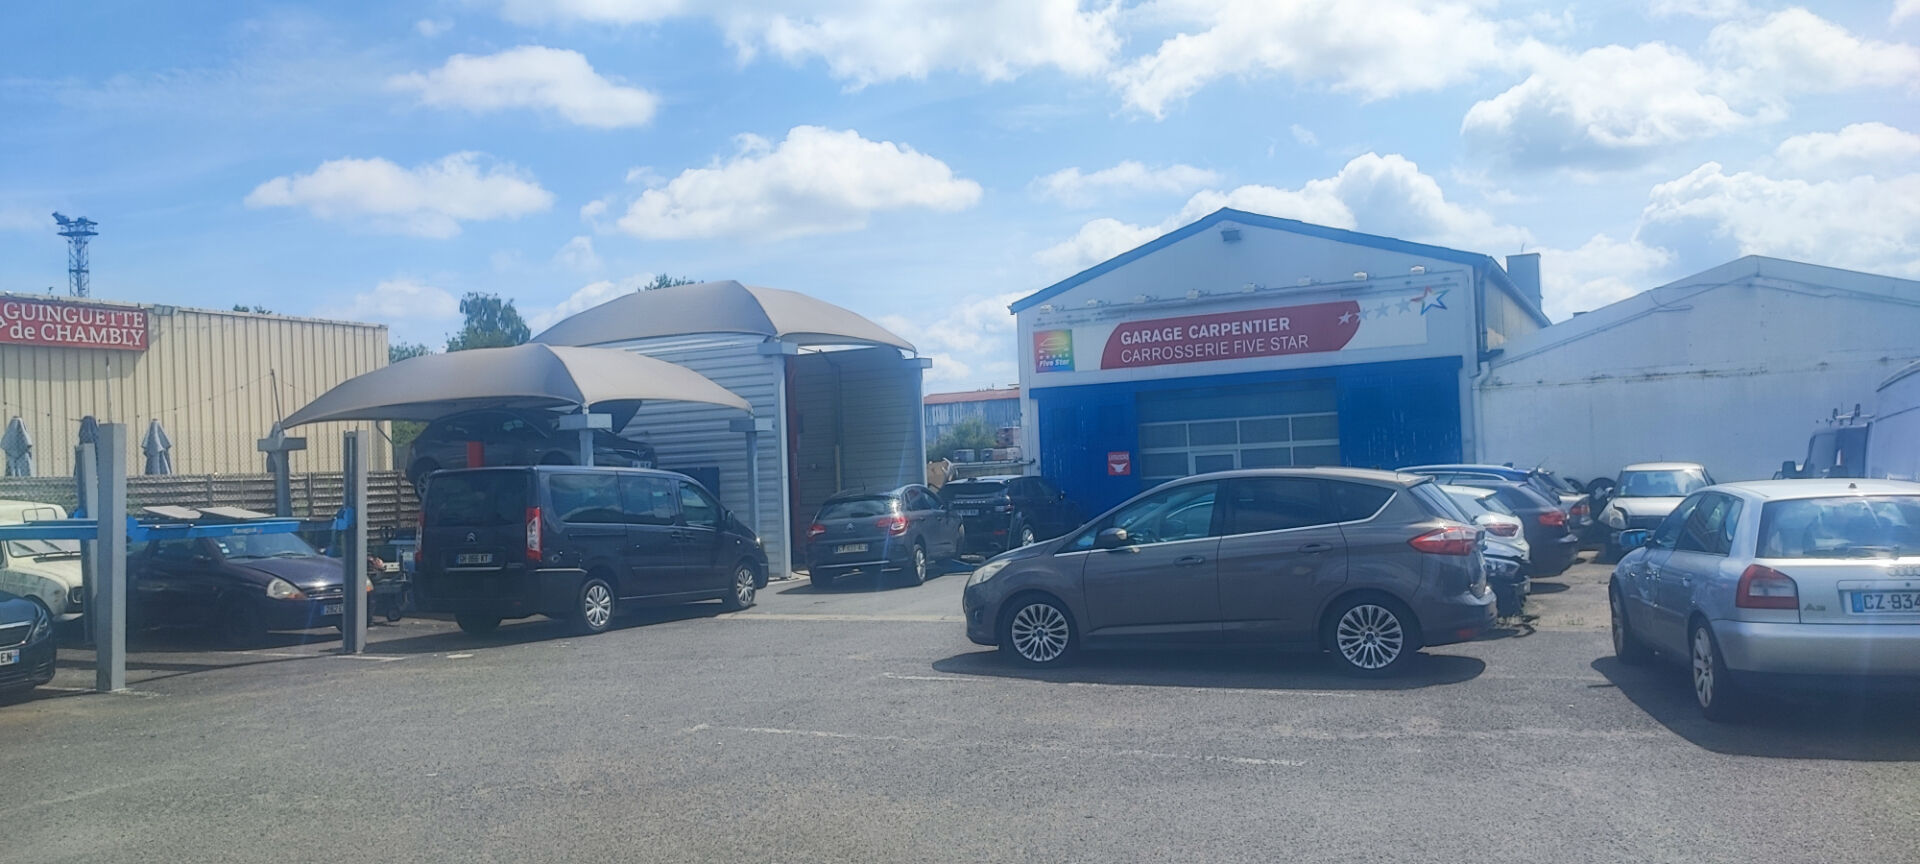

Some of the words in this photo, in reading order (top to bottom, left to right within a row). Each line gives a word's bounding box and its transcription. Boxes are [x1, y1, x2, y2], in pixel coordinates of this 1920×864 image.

[3, 301, 144, 328] GUINGUETTE
[10, 320, 36, 340] de
[41, 323, 144, 346] CHAMBLY
[1120, 327, 1183, 345] GARAGE
[1188, 317, 1290, 339] CARPENTIER
[1121, 341, 1229, 364] CARROSSERIE
[1234, 338, 1265, 354] FIVE
[1270, 334, 1309, 351] STAR
